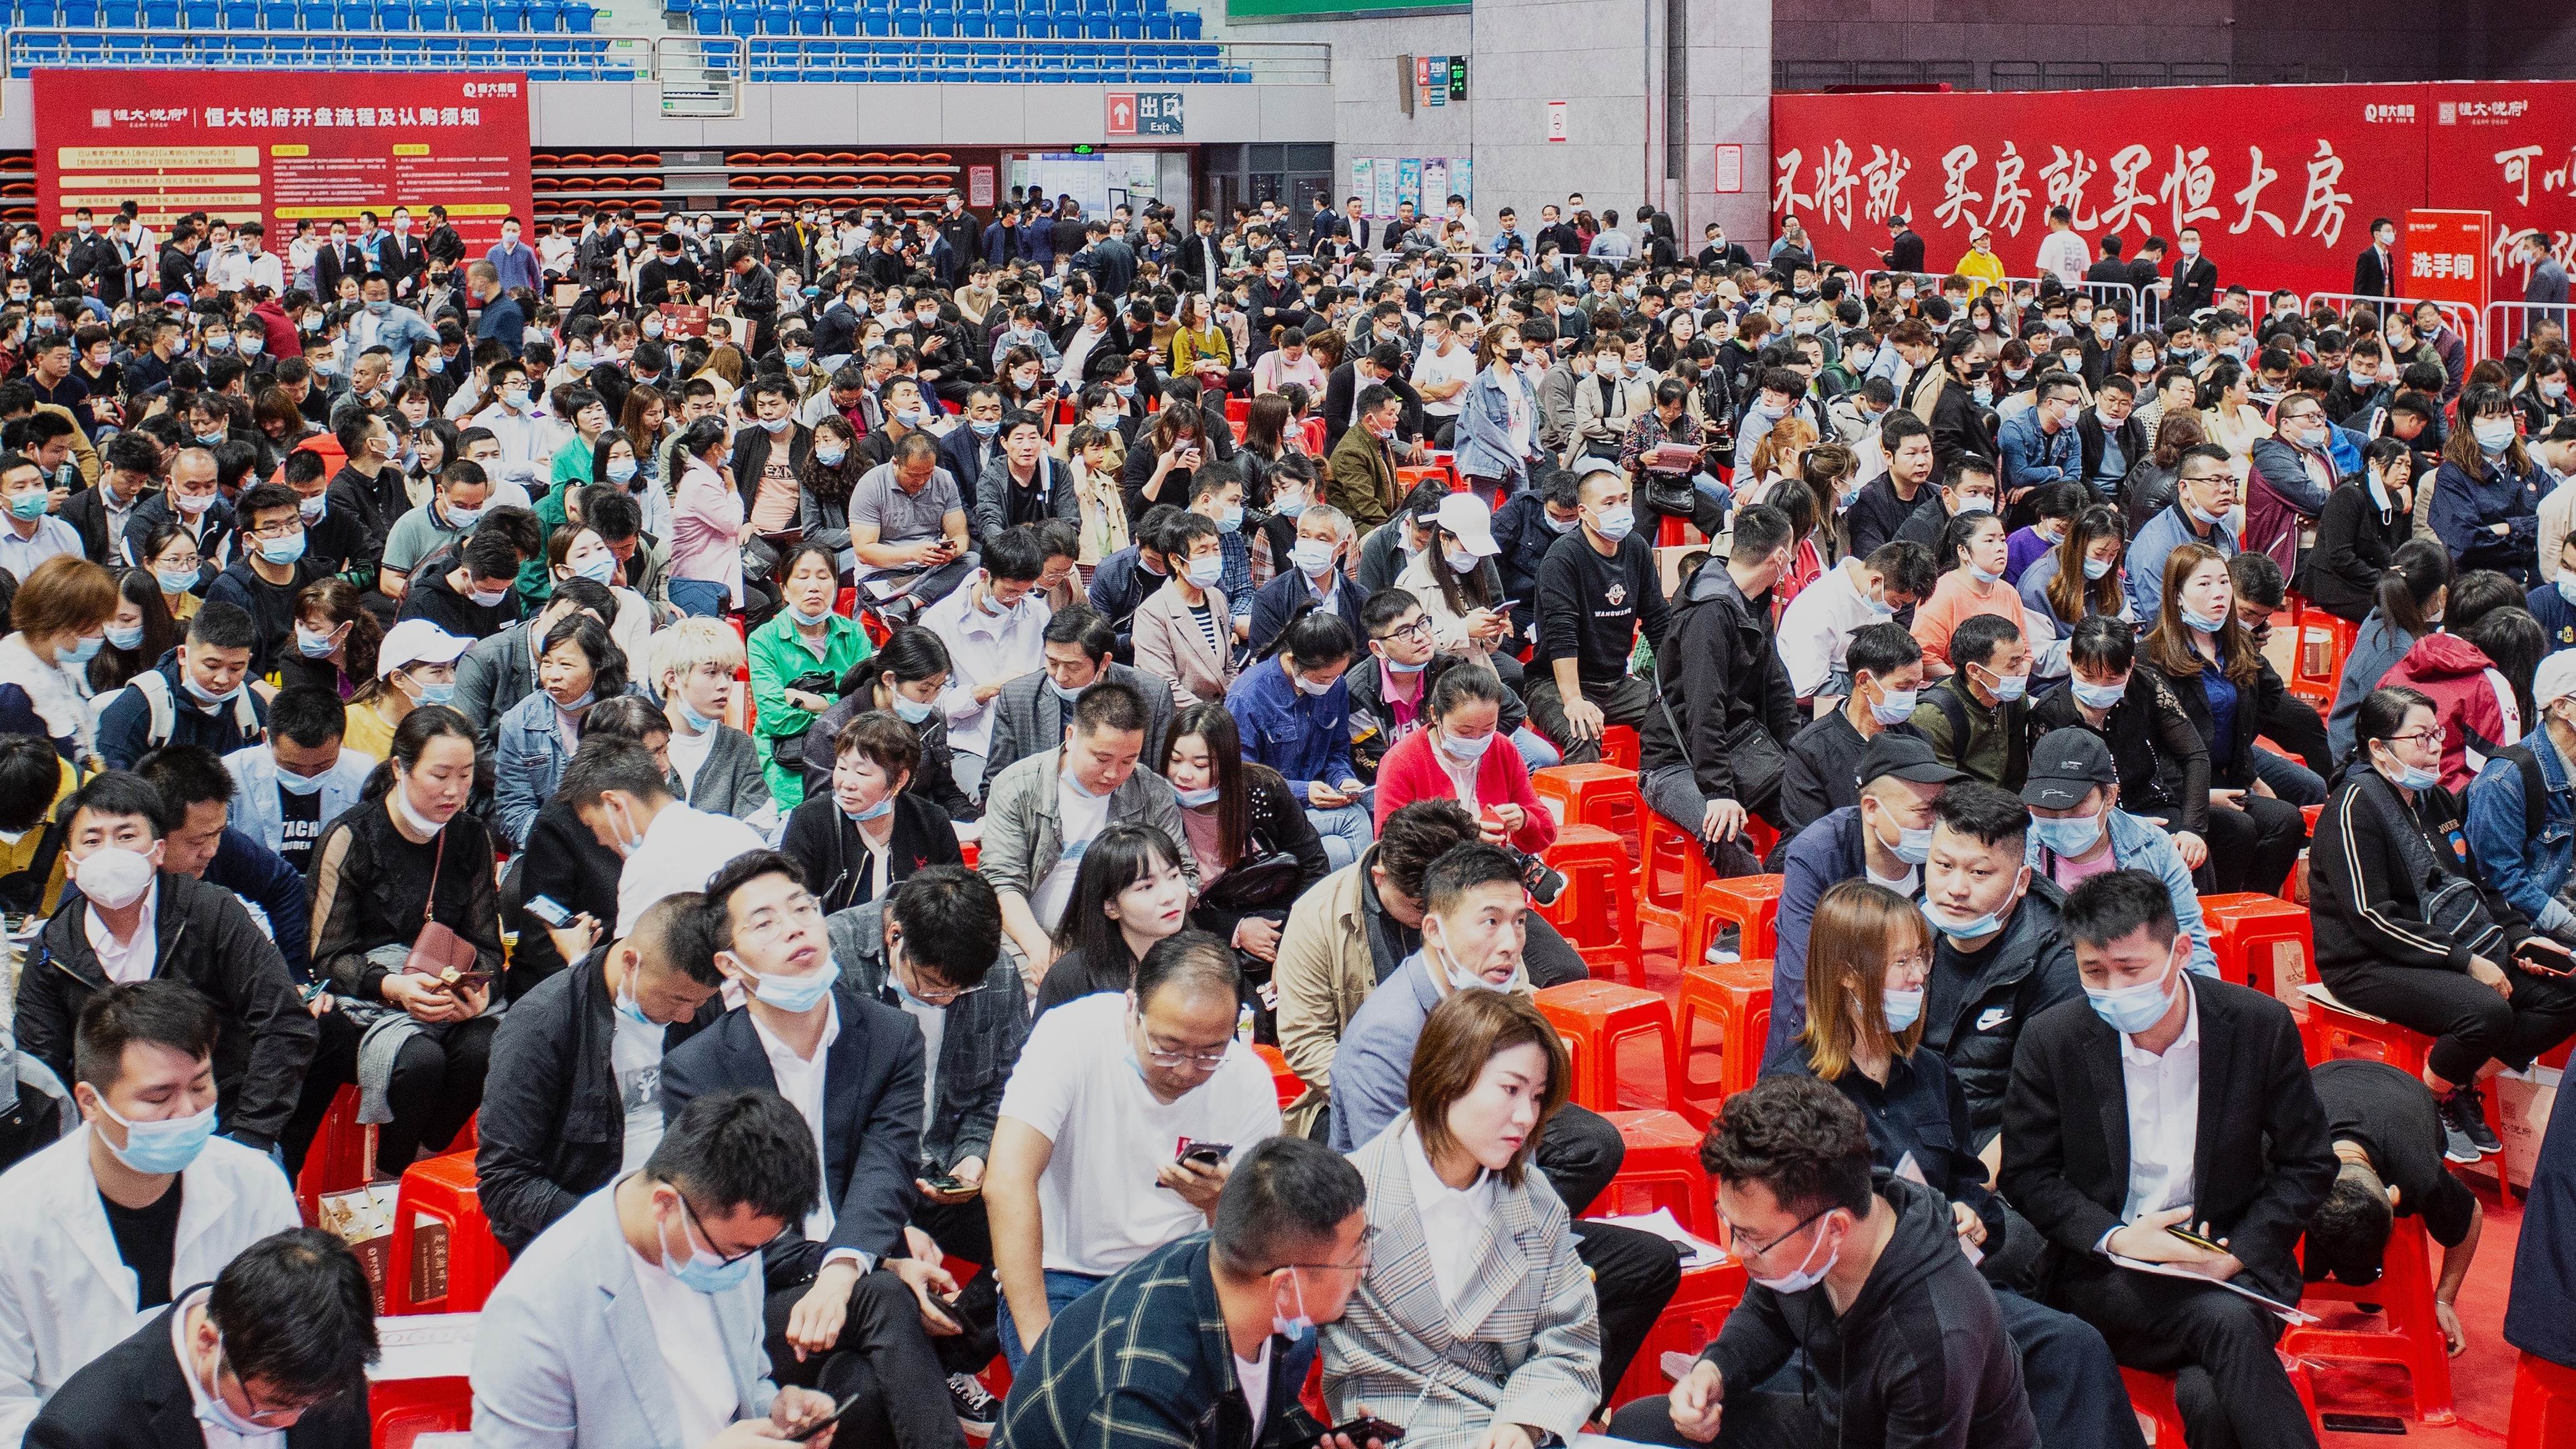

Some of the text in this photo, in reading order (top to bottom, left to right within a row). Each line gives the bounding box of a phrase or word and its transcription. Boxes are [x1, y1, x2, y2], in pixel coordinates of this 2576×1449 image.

[204, 107, 480, 127] 恒大悦府开盘流程及认购须知
[1140, 96, 1179, 117] 出口
[1151, 122, 1170, 131] Exit
[1773, 138, 2354, 249] 不将就 买房就买恒大房
[2412, 252, 2474, 280] 洗手间
